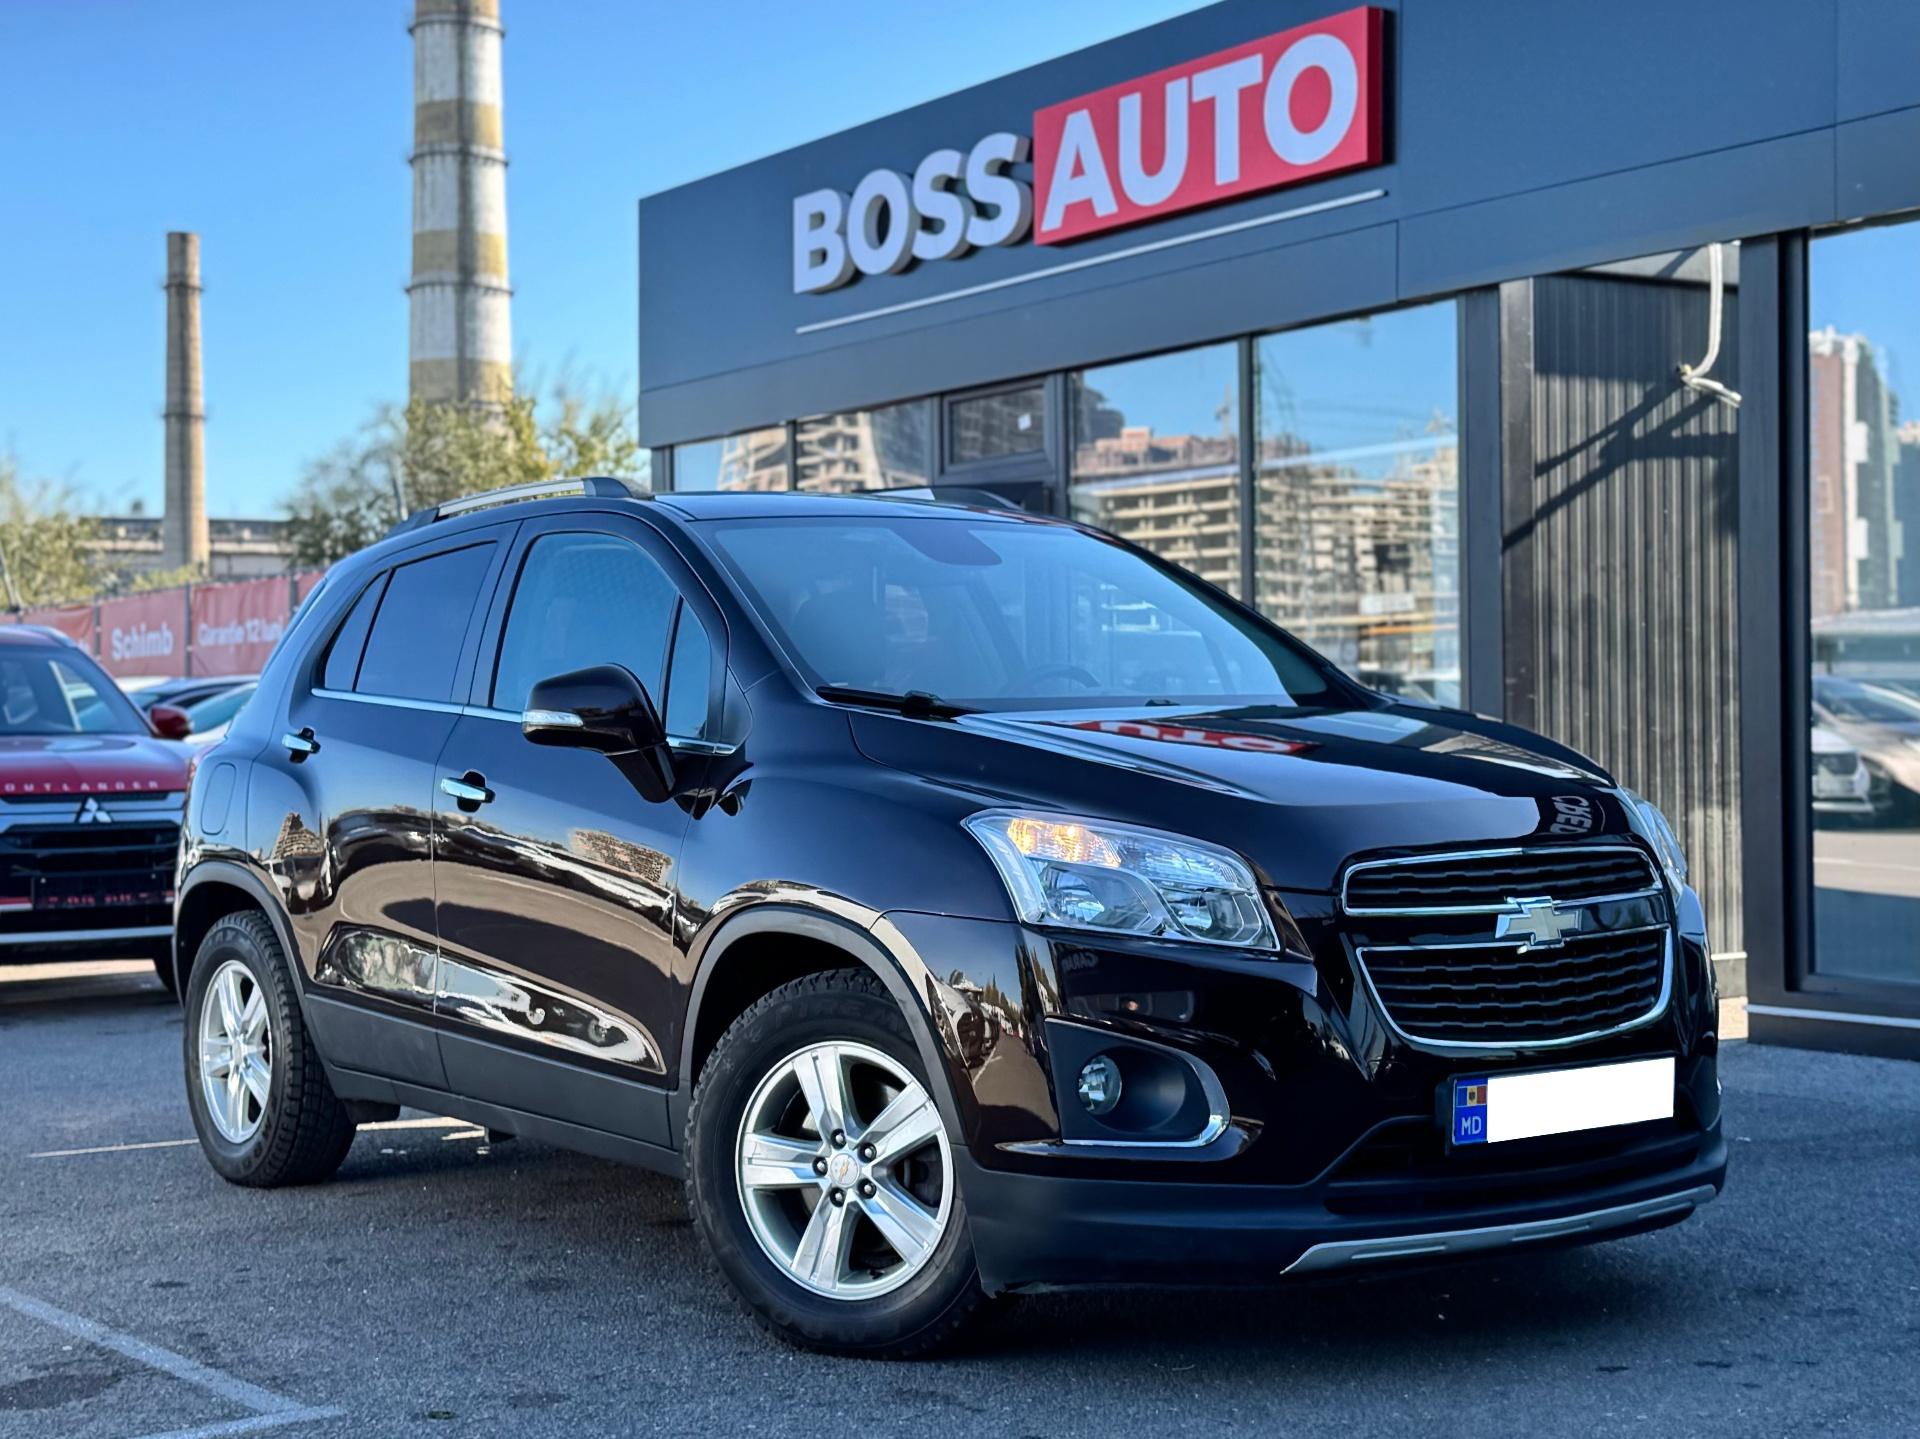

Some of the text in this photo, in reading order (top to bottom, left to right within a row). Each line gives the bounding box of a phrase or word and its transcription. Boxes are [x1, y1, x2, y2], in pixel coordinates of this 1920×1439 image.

[793, 33, 1359, 294] BOSS AUTO
[111, 622, 174, 660] Schimb
[4, 780, 159, 793] OUTLANDER
[1460, 1115, 1482, 1136] MD
